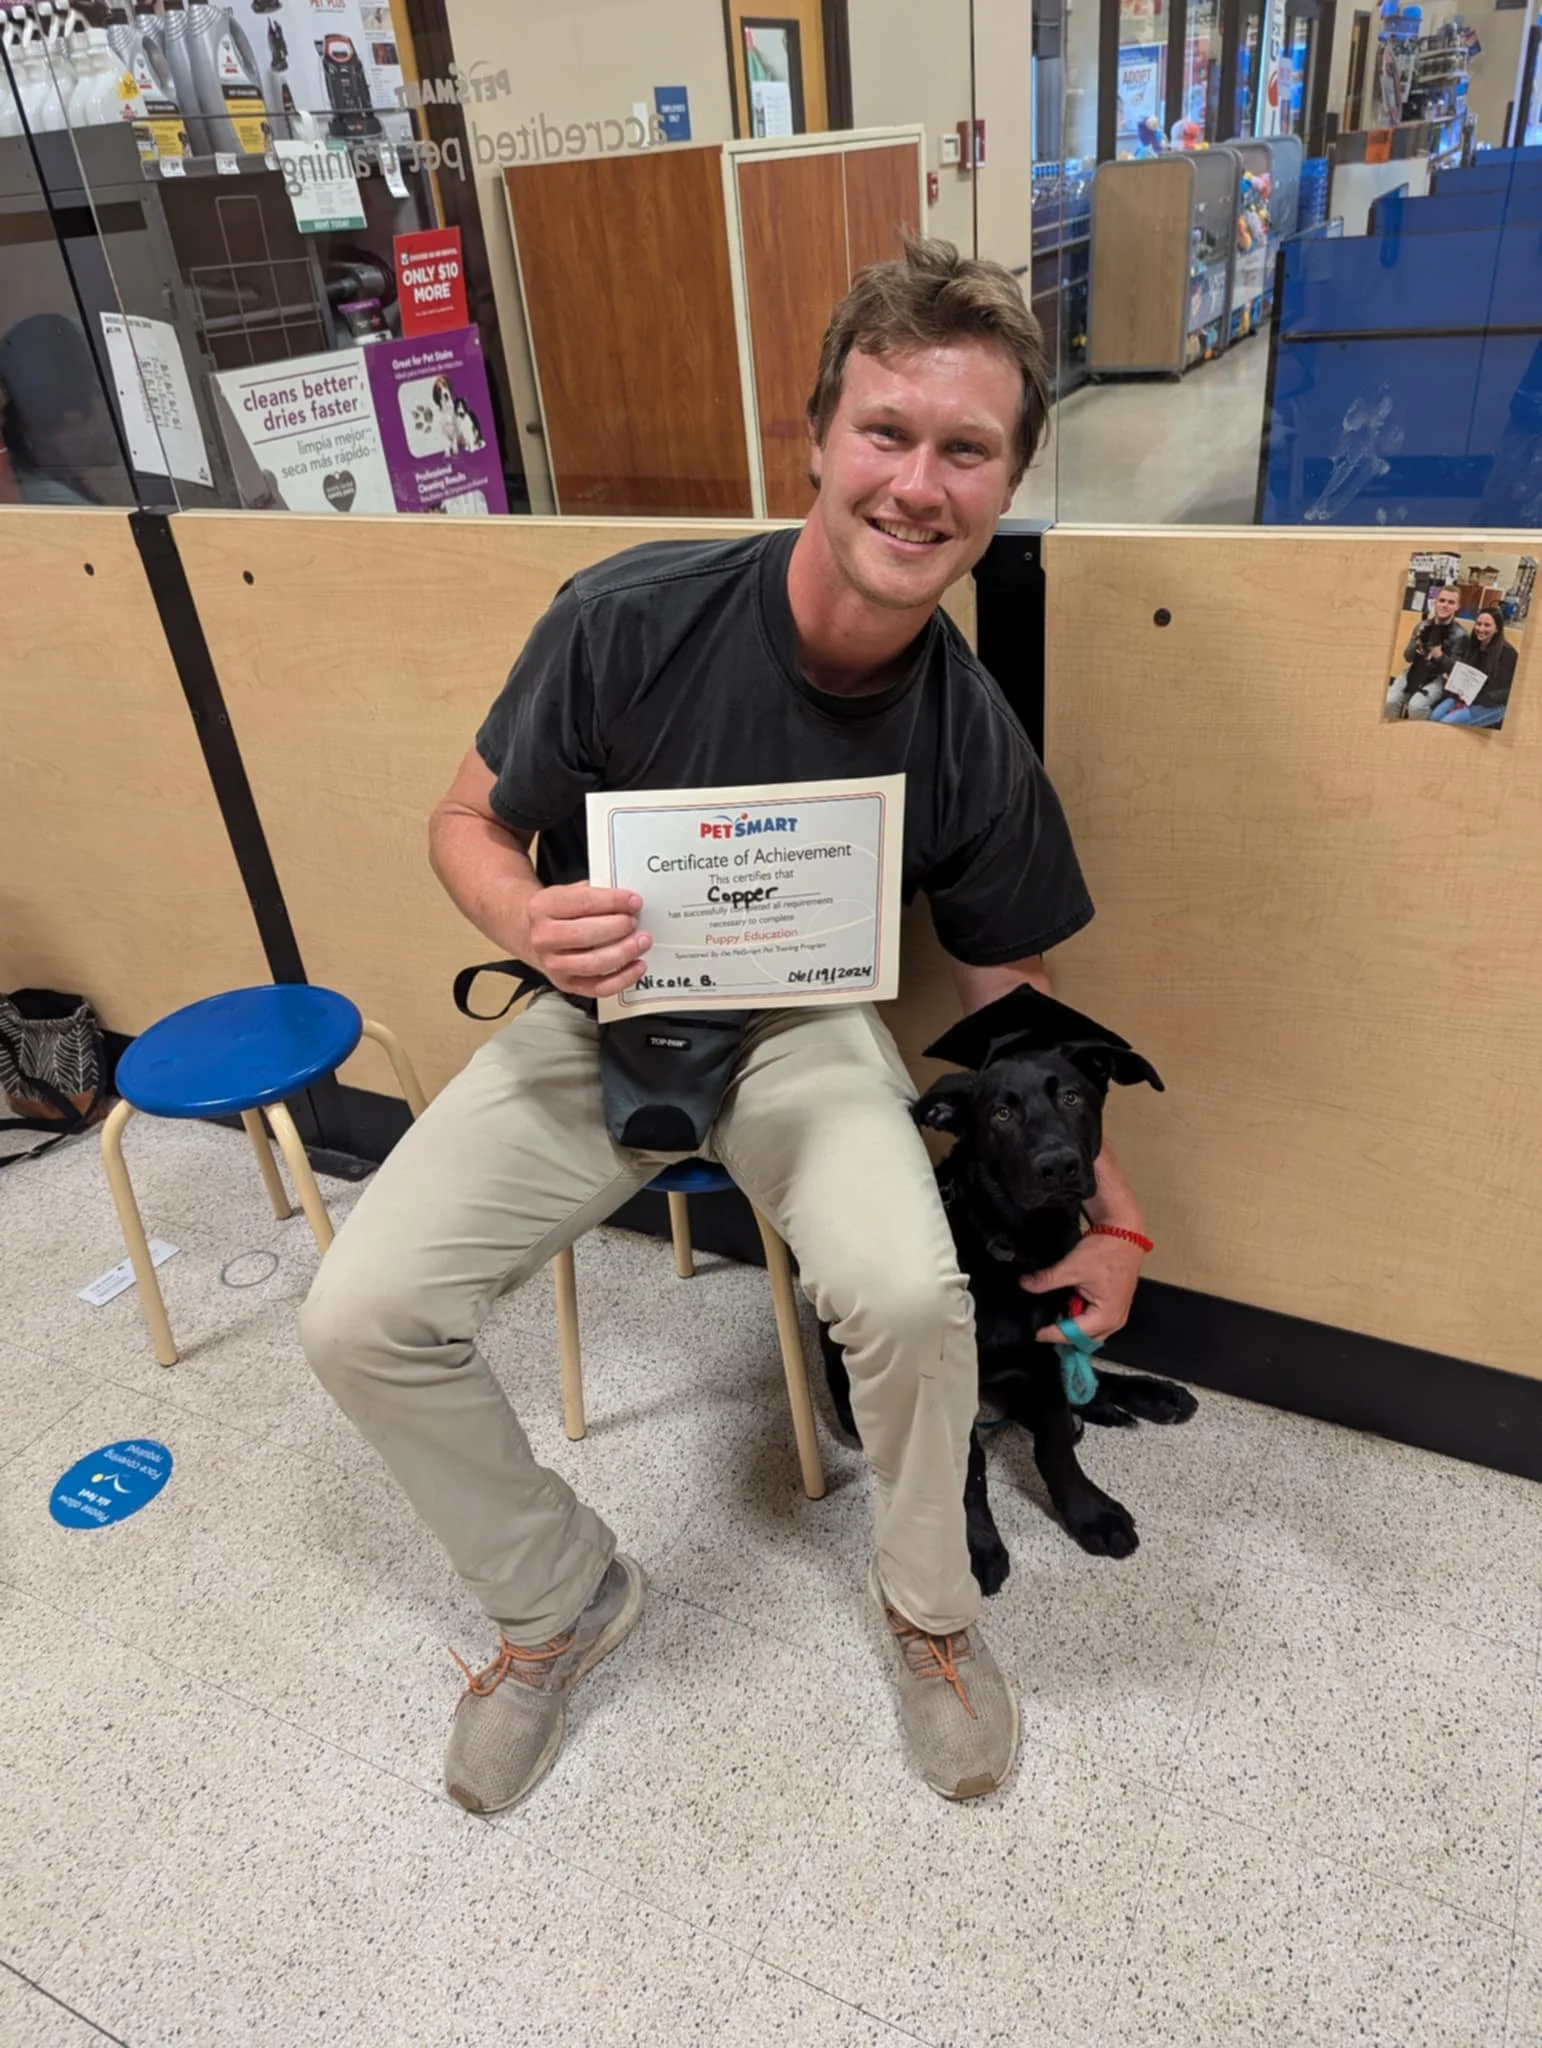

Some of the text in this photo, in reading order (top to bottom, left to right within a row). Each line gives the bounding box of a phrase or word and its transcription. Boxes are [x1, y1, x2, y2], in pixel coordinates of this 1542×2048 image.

[402, 262, 459, 286] ONLY $10
[413, 281, 451, 304] MORE
[243, 386, 298, 411] cleans
[263, 397, 358, 431] dries faster
[296, 433, 333, 455] limpia
[281, 462, 308, 478] seca
[309, 453, 333, 471] más
[647, 844, 852, 873] Certificate of Achievement
[710, 869, 794, 884] This certifies that
[668, 909, 681, 918] has
[684, 905, 728, 917] successfully
[773, 900, 781, 909] all
[784, 896, 833, 908] requirements
[707, 885, 778, 909] Copper
[709, 919, 746, 929] necessary
[759, 913, 794, 924] complete
[705, 928, 798, 946] Puppy Education
[635, 973, 717, 991] Nicole B.
